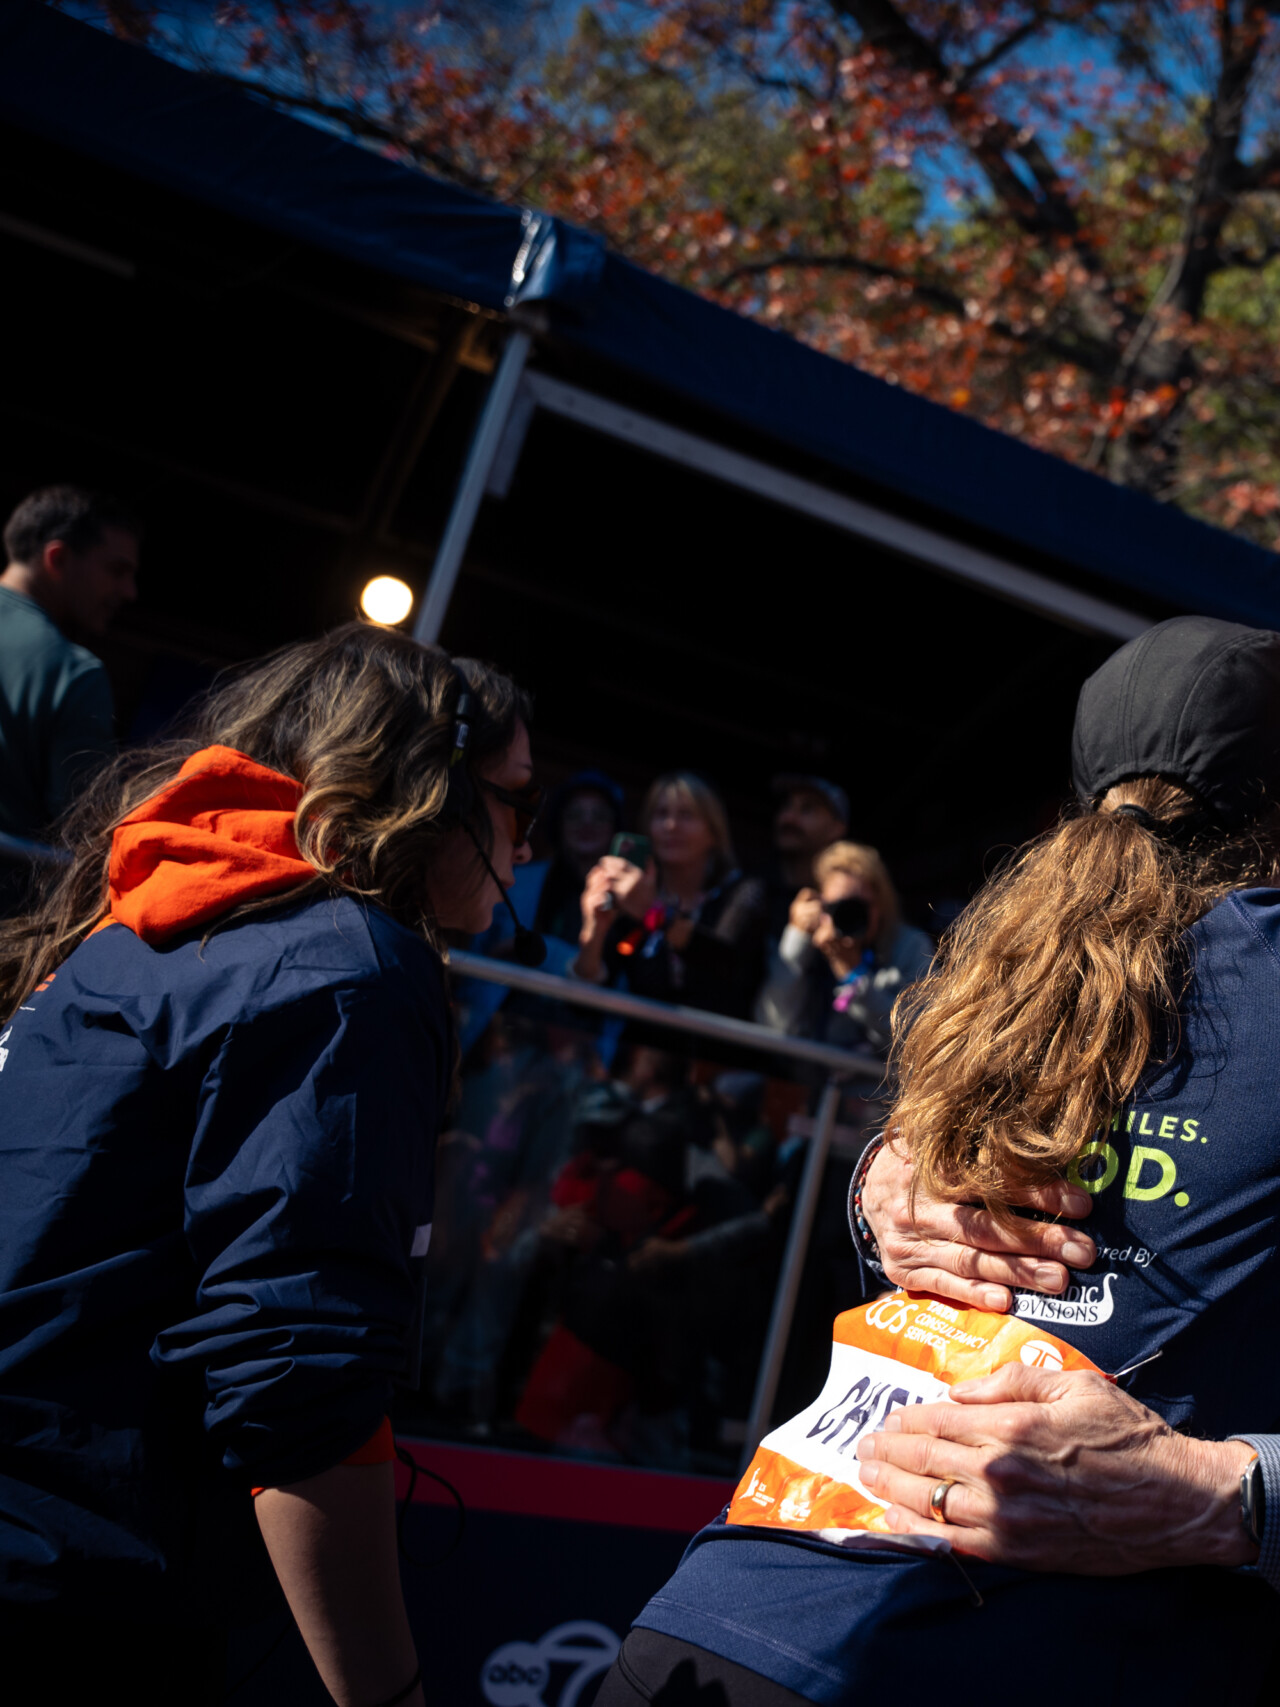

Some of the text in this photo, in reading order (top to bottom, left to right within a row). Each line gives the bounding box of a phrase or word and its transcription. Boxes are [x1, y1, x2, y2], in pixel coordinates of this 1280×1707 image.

[1134, 1247, 1157, 1268] By
[926, 1300, 959, 1323] TATA
[904, 1325, 950, 1350] SERVICES
[914, 1313, 989, 1350] CONSULTANCY
[487, 1660, 543, 1685] abc
